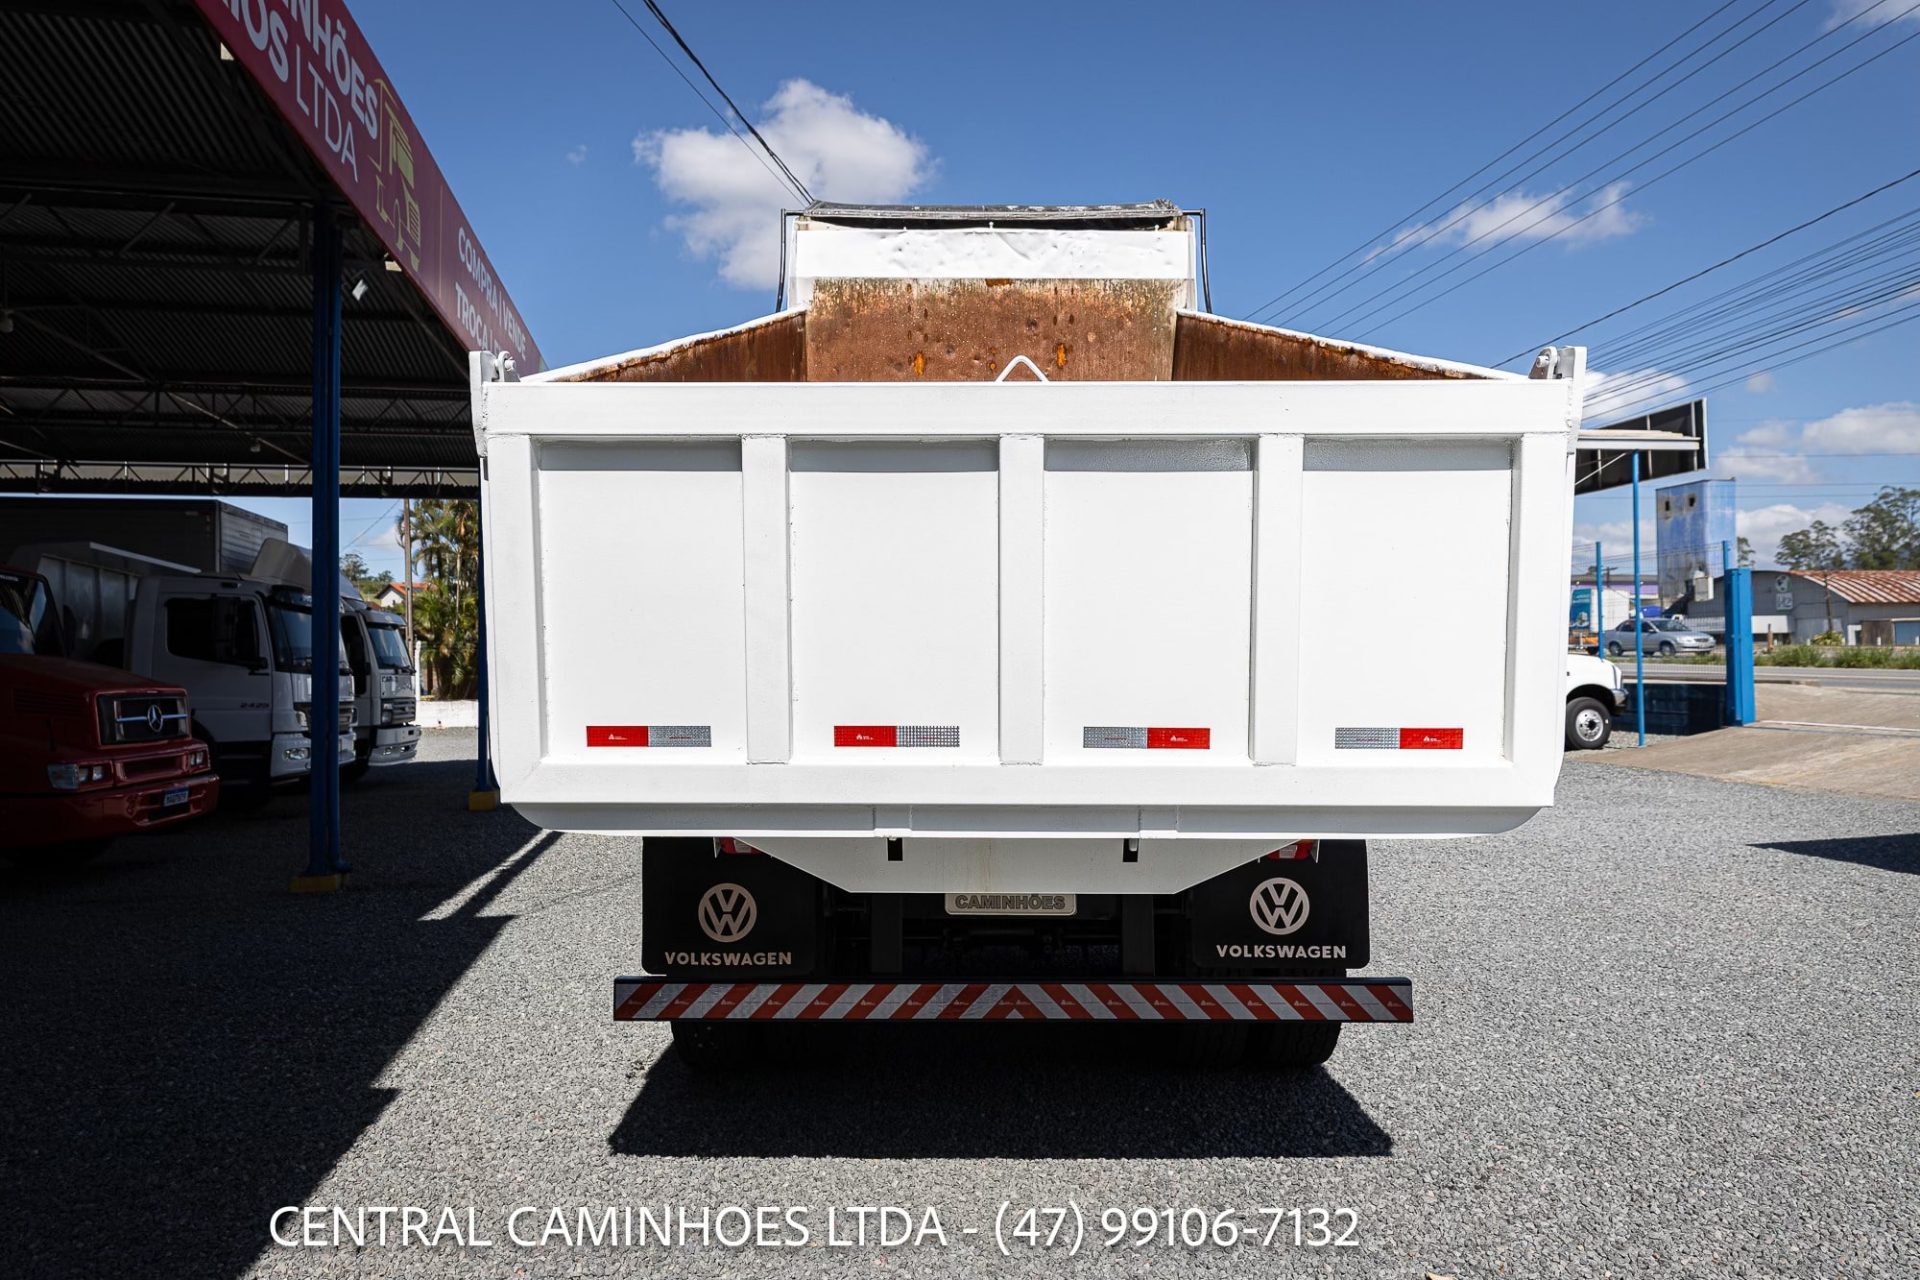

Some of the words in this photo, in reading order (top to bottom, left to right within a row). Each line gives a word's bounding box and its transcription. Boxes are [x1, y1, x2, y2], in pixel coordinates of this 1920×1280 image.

[282, 0, 378, 140] NHÕES
[296, 44, 359, 183] LTDA
[455, 281, 488, 352] TROCA
[458, 227, 498, 317] COMPRA
[502, 301, 526, 360] VENDE
[664, 951, 792, 966] VOLKSWAGEN
[1216, 944, 1347, 959] VOLKSWAGEN
